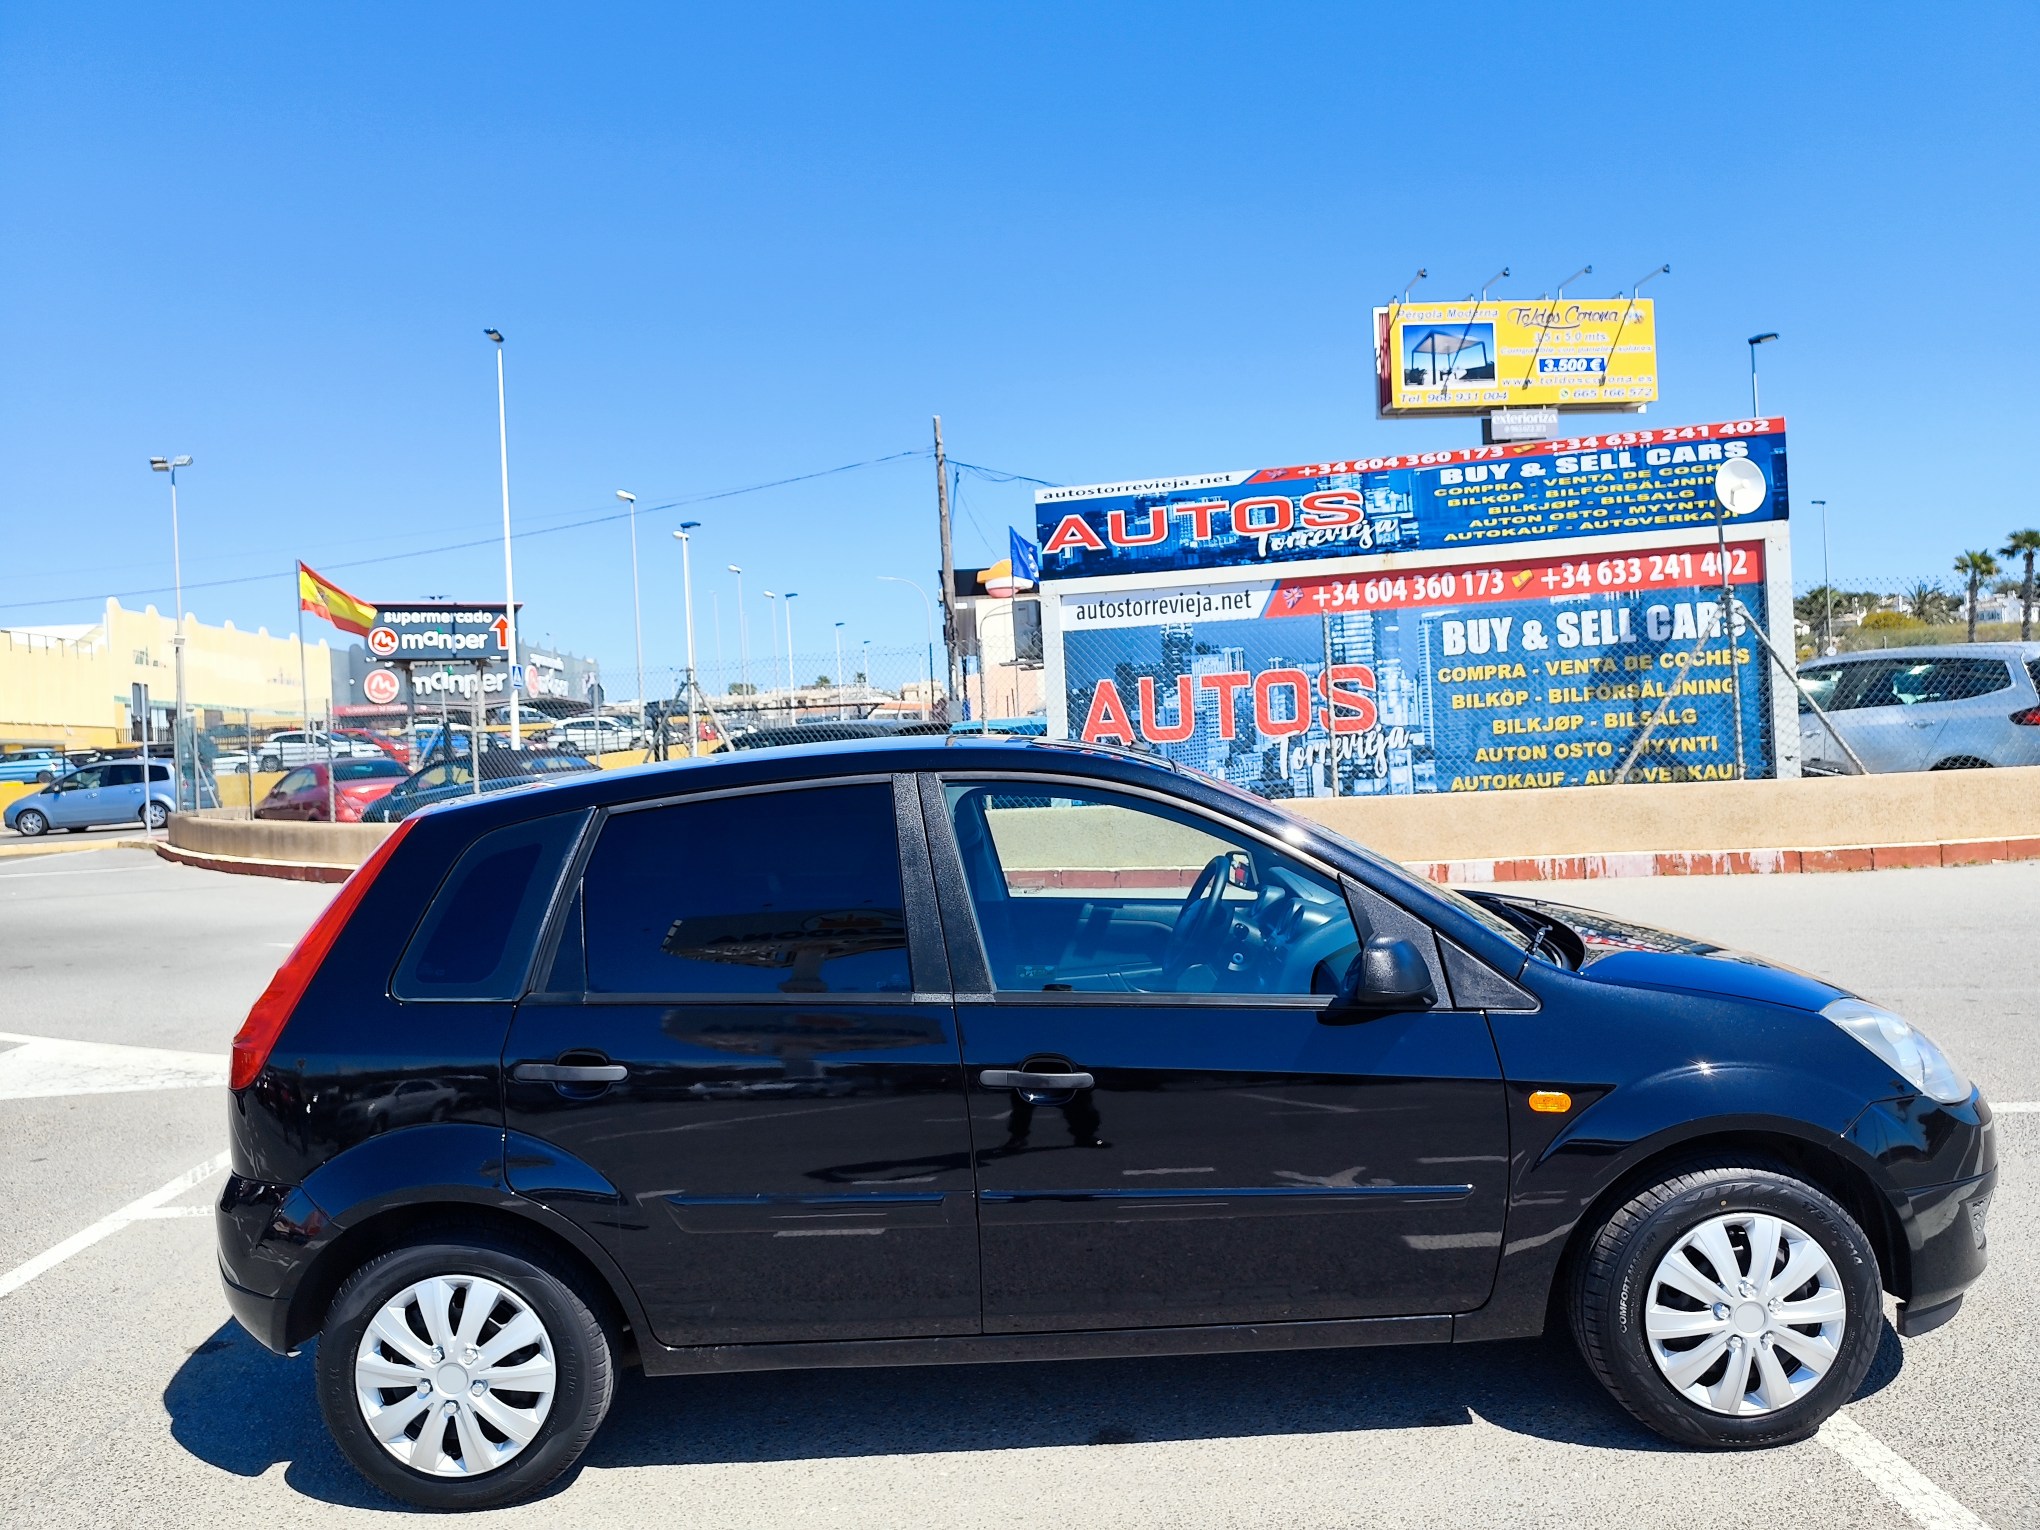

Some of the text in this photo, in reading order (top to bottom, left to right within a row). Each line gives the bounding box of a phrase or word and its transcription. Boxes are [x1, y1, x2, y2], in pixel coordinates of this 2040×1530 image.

[1564, 305, 1618, 324] Corona
[1543, 358, 1603, 372] 3.500 €
[1491, 411, 1558, 424] exterioriza
[1544, 420, 1770, 452] +34 633 241 402
[1297, 446, 1504, 476] +34 604 360 173
[1439, 440, 1749, 486] BUY & SELL CARS
[1043, 474, 1233, 500] autostorrevieja.net
[1433, 481, 1523, 497] COMPRA
[1543, 473, 1616, 488] VENTA
[1622, 469, 1652, 480] DE
[1658, 463, 1721, 476] COCH
[1447, 492, 1525, 508] BILKÖP
[1545, 476, 1716, 499] BILFÖRSÄLJNIN
[1468, 514, 1543, 528] AUTON
[1549, 508, 1608, 521] OSTO
[1628, 499, 1716, 515] MYYNTI
[1488, 499, 1581, 516] BILKJØP
[1600, 489, 1695, 506] BILSALG
[1041, 488, 1364, 555] AUTOS
[1443, 524, 1559, 542] AUTOKAUF
[1250, 518, 1398, 557] Torrevieja
[1540, 548, 1748, 590] +34 633 241 402
[1312, 568, 1505, 607] +34 604 360 173
[383, 610, 493, 627] supermercado
[1076, 589, 1253, 620] autostorrevieja.net
[401, 630, 489, 653] manper
[1441, 599, 1747, 657] BUY & SELL CARS
[1437, 663, 1527, 683] COMPRA
[1545, 656, 1617, 676] VENTA
[1624, 655, 1653, 671] DE
[1659, 648, 1750, 669] COCHES
[1081, 664, 1378, 746] AUTOS
[1451, 688, 1529, 709] BILKÖP
[1492, 714, 1584, 735] BILKJØP
[1604, 708, 1698, 729] BILSALG
[1274, 724, 1412, 780] Torrevieja
[1474, 745, 1548, 763] AUTON
[1554, 741, 1613, 759] OSTO
[1451, 772, 1566, 792] AUTOKAUF
[1584, 763, 1737, 785] AUOVERKAU
[1619, 1275, 1632, 1334] COMFORT
